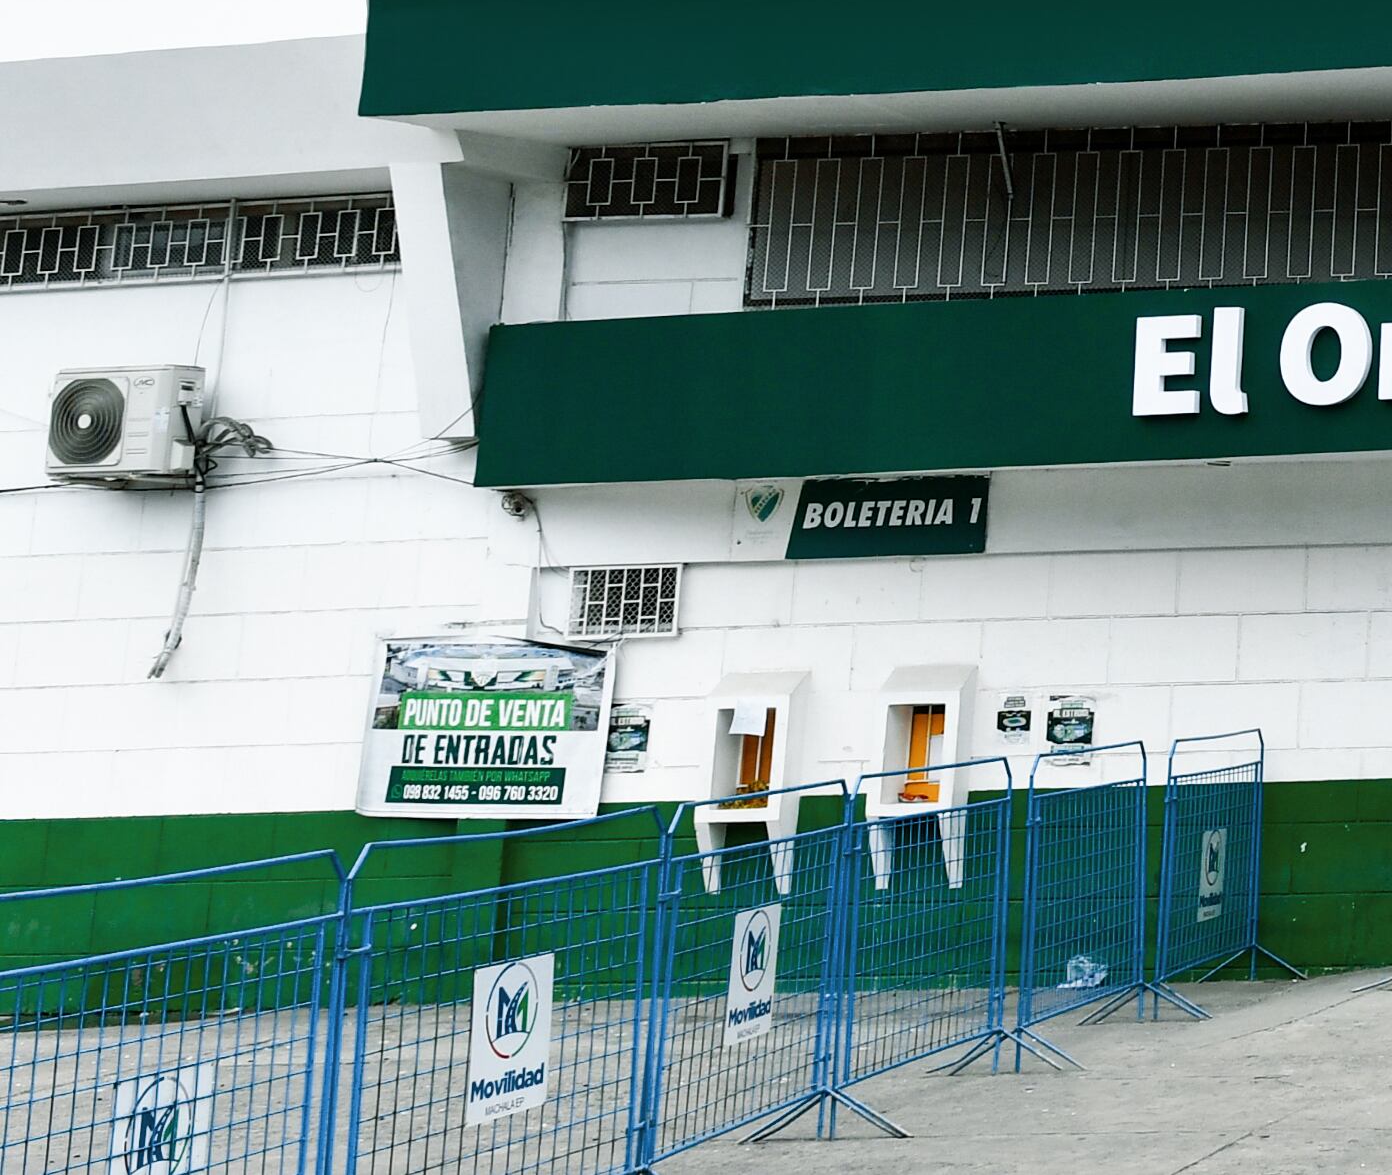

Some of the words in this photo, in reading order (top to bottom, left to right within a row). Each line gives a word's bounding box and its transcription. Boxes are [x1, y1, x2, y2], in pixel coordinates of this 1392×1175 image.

[1132, 306, 1249, 417] El
[802, 498, 955, 530] BOLETERIA
[969, 497, 982, 524] 1
[403, 697, 463, 727] PUNTO
[464, 698, 494, 727] DE
[498, 699, 566, 727] VENTA
[401, 733, 429, 765] DE
[432, 733, 558, 766] ENTRADAS
[443, 784, 470, 802] 1455
[478, 785, 502, 801] 096
[503, 785, 527, 801] 760
[527, 785, 559, 801] 3320
[485, 771, 503, 783] POR
[504, 771, 552, 783] WHATSAPP
[727, 995, 773, 1028] Movilidad
[469, 1062, 546, 1104] Movilidad
